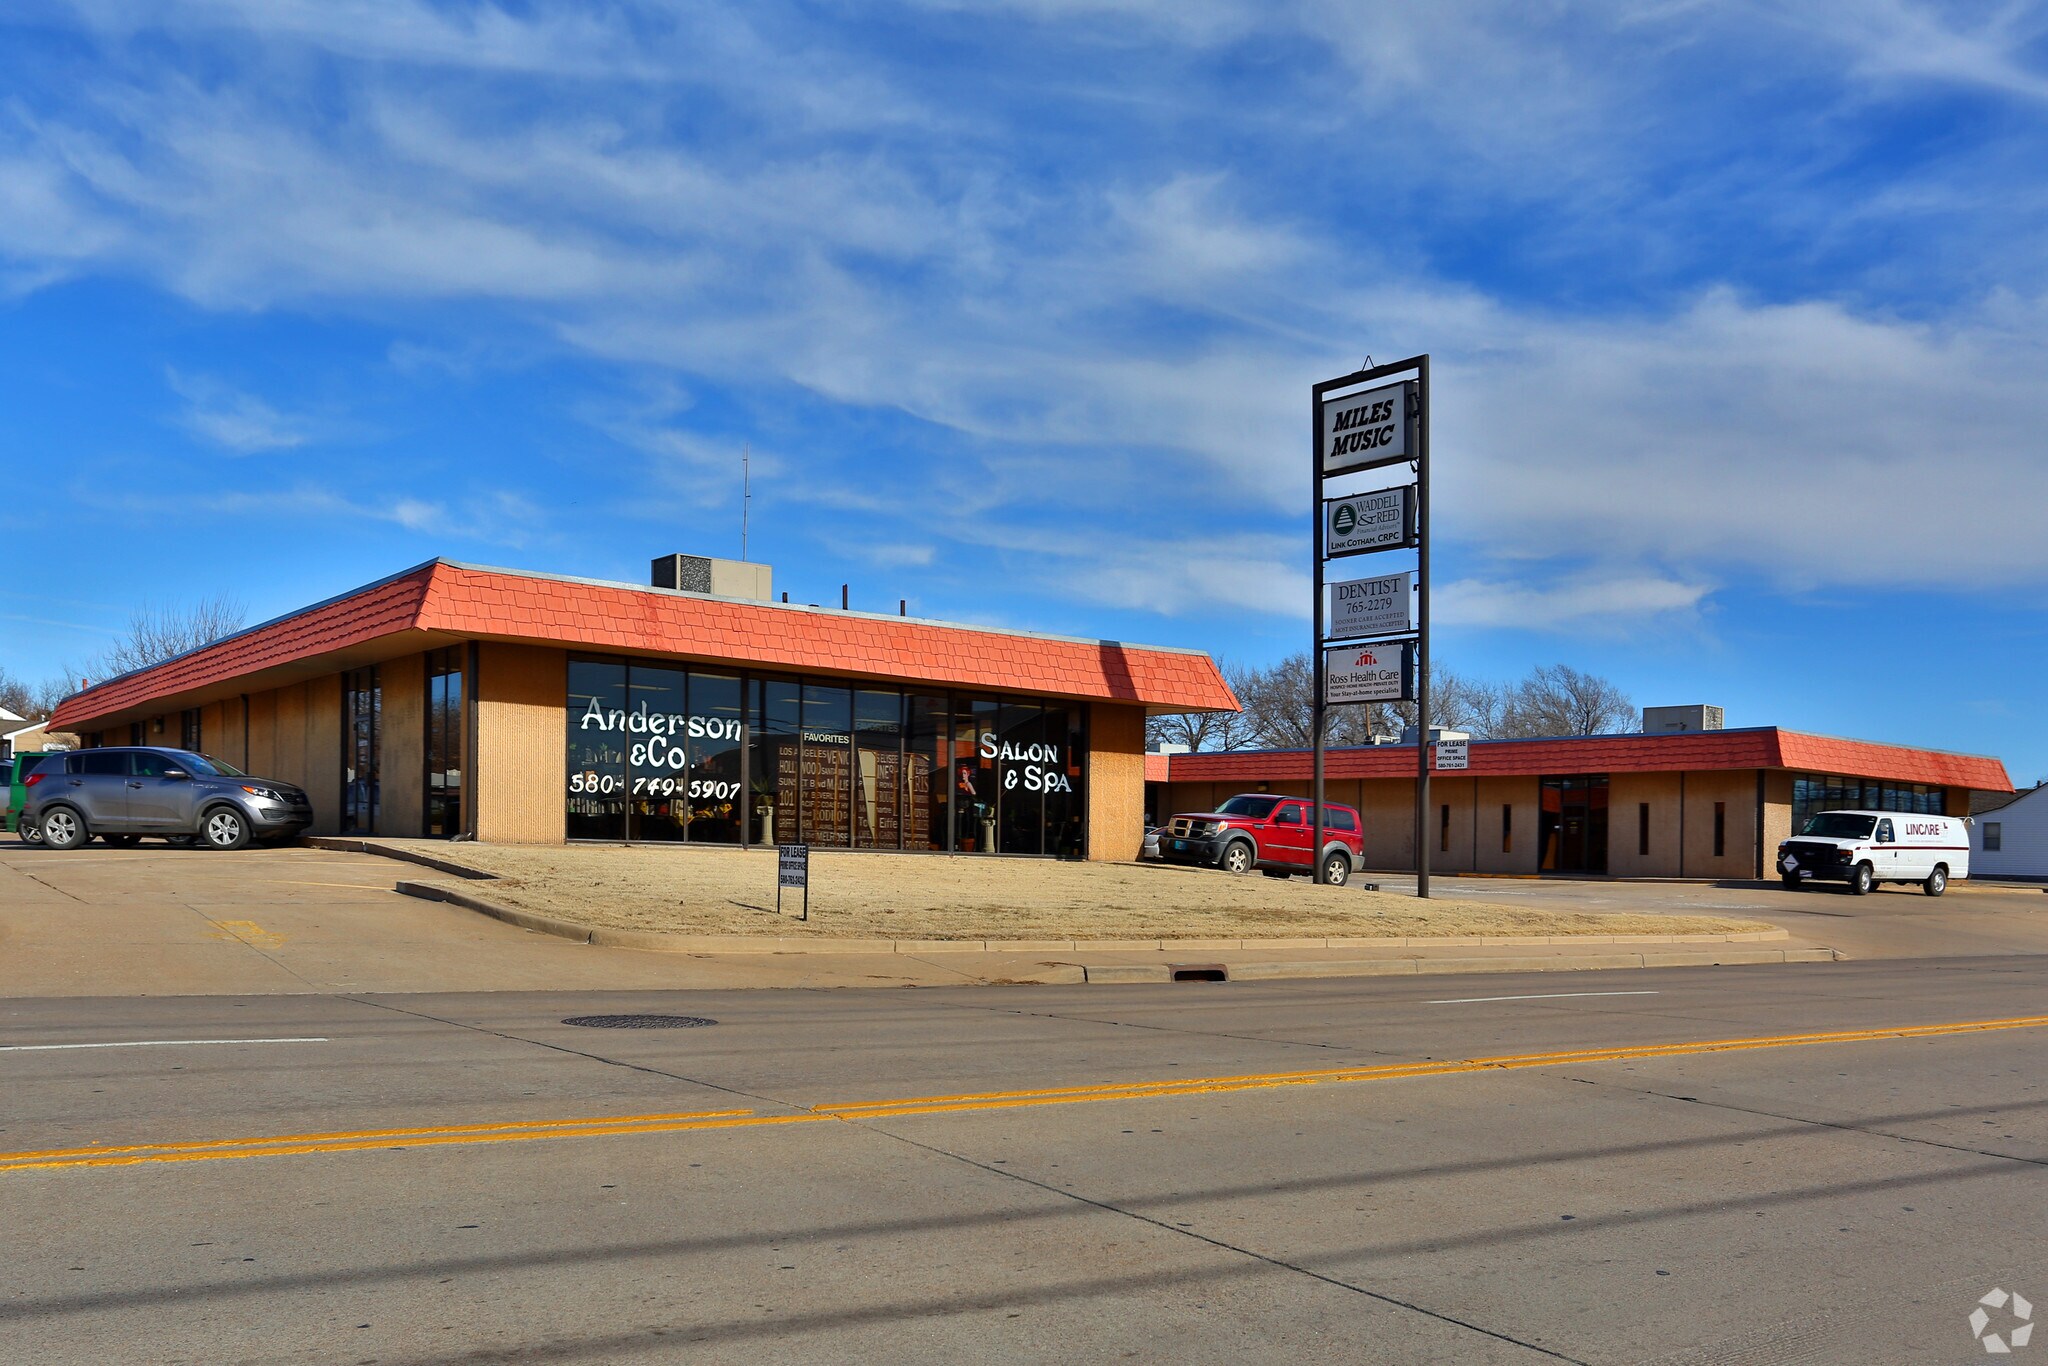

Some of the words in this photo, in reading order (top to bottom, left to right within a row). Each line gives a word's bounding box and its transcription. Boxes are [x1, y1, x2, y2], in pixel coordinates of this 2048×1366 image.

[1333, 399, 1394, 432] MILES
[1330, 424, 1395, 457] MUSIC
[1356, 495, 1400, 512] WADDELL
[1378, 531, 1399, 542] CRPC
[1338, 578, 1400, 600] DENTIST
[1346, 597, 1392, 614] 765-2279
[1330, 674, 1348, 684] Ross
[1350, 670, 1377, 682] Health
[1379, 669, 1399, 680] Care
[581, 697, 742, 741] Anderson
[804, 733, 850, 744] FAVORITES
[779, 747, 793, 756] LOS
[1005, 769, 1018, 789] &
[779, 790, 794, 806] 101
[1905, 823, 1940, 836] LINCARE
[791, 846, 806, 858] LEASE
